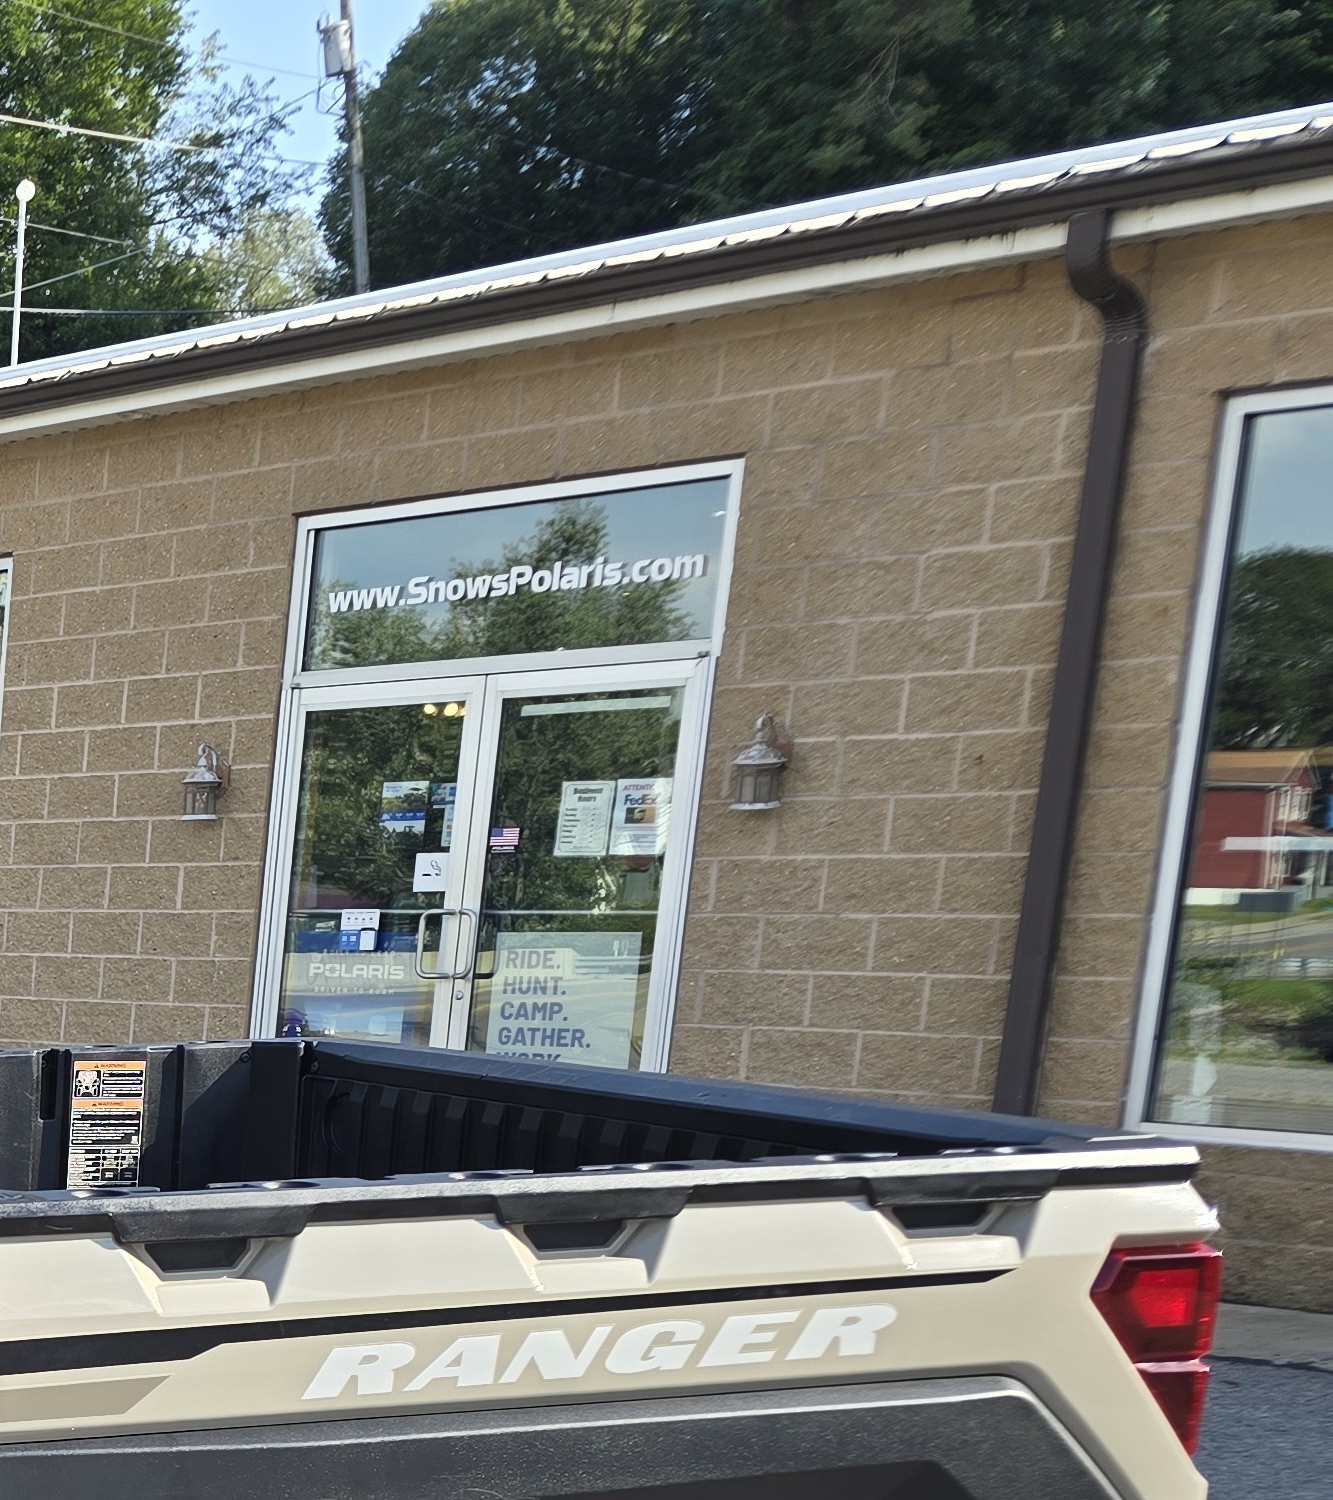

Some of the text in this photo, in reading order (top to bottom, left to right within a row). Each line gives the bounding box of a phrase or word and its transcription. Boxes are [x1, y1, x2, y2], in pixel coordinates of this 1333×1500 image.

[329, 553, 706, 613] www.SnowsPolaris.com
[505, 950, 561, 970] RIDE.
[309, 963, 405, 980] POLARIS
[502, 976, 566, 995] HUNT.
[500, 1002, 568, 1022] CAMP.
[498, 1026, 591, 1048] GATHER.
[300, 1303, 898, 1400] RANGER
